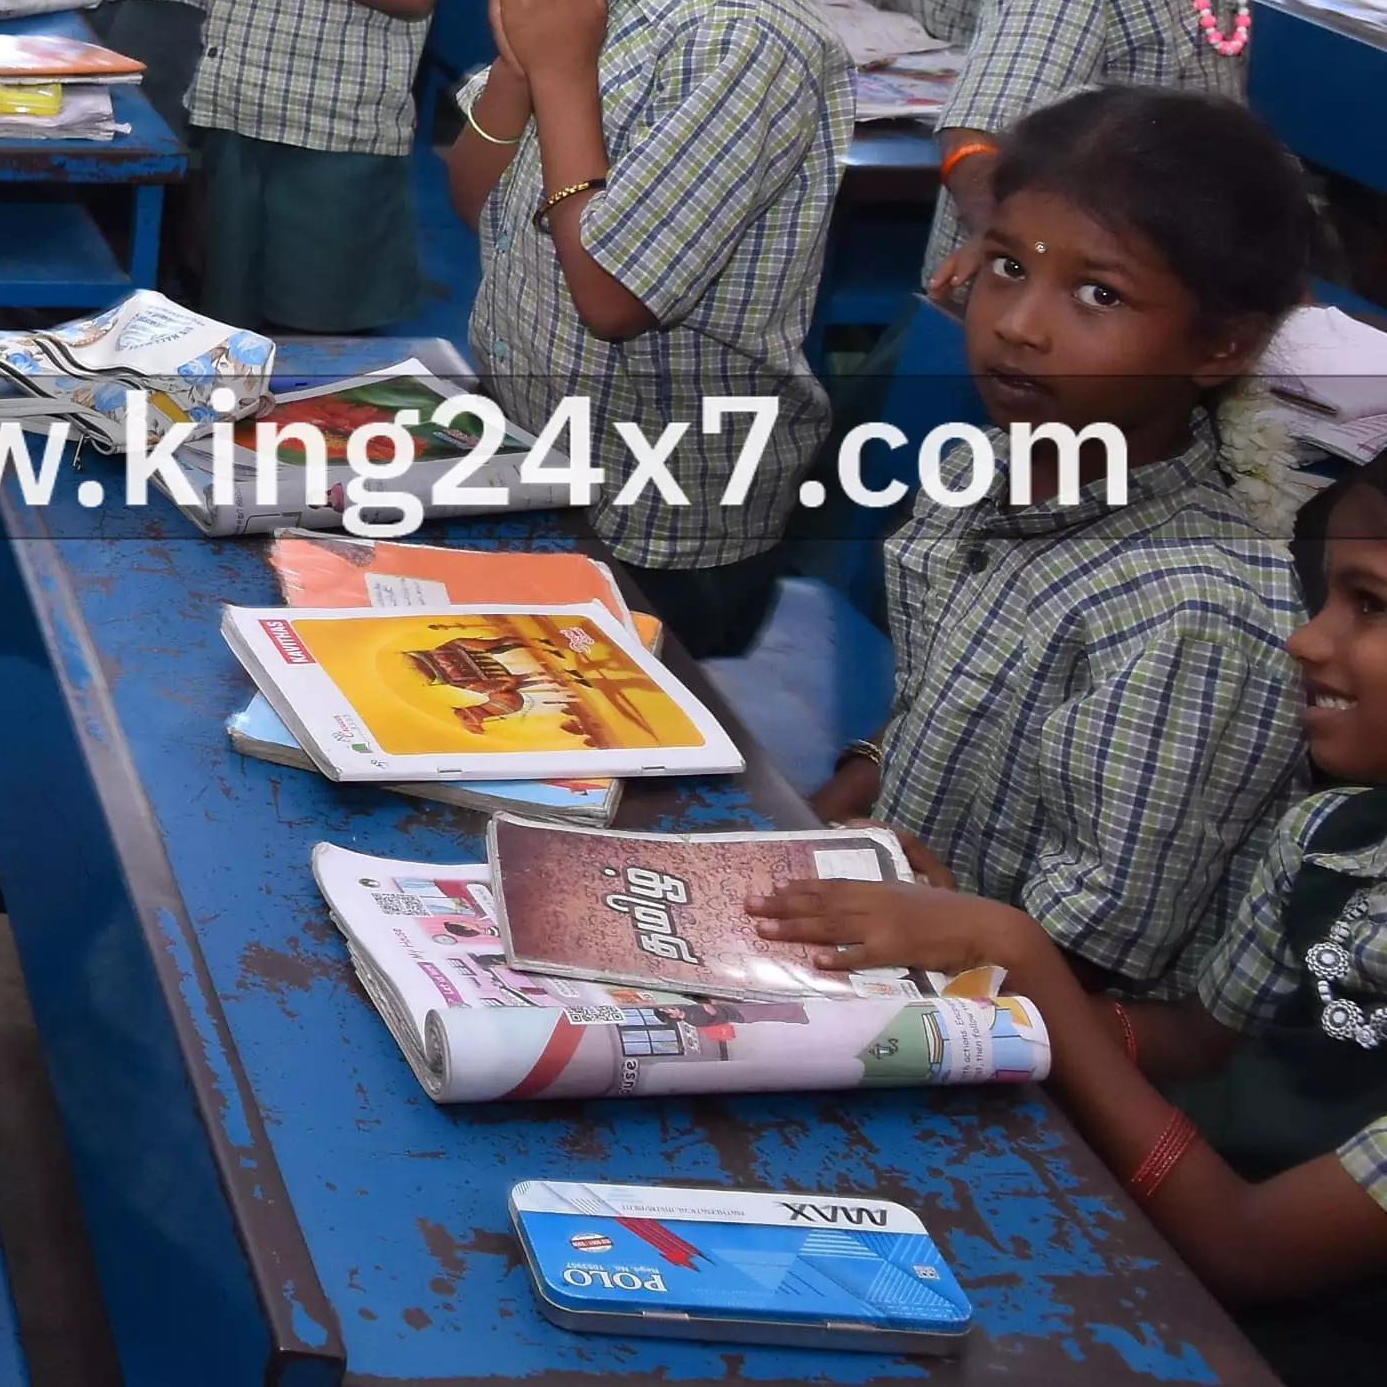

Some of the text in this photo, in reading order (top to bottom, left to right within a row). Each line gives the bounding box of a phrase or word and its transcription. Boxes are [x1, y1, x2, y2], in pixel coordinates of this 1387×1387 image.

[265, 620, 310, 663] KAVITHAS
[603, 866, 697, 964] தமிழ்
[780, 1201, 888, 1227] MAX
[562, 1269, 668, 1293] POLO
